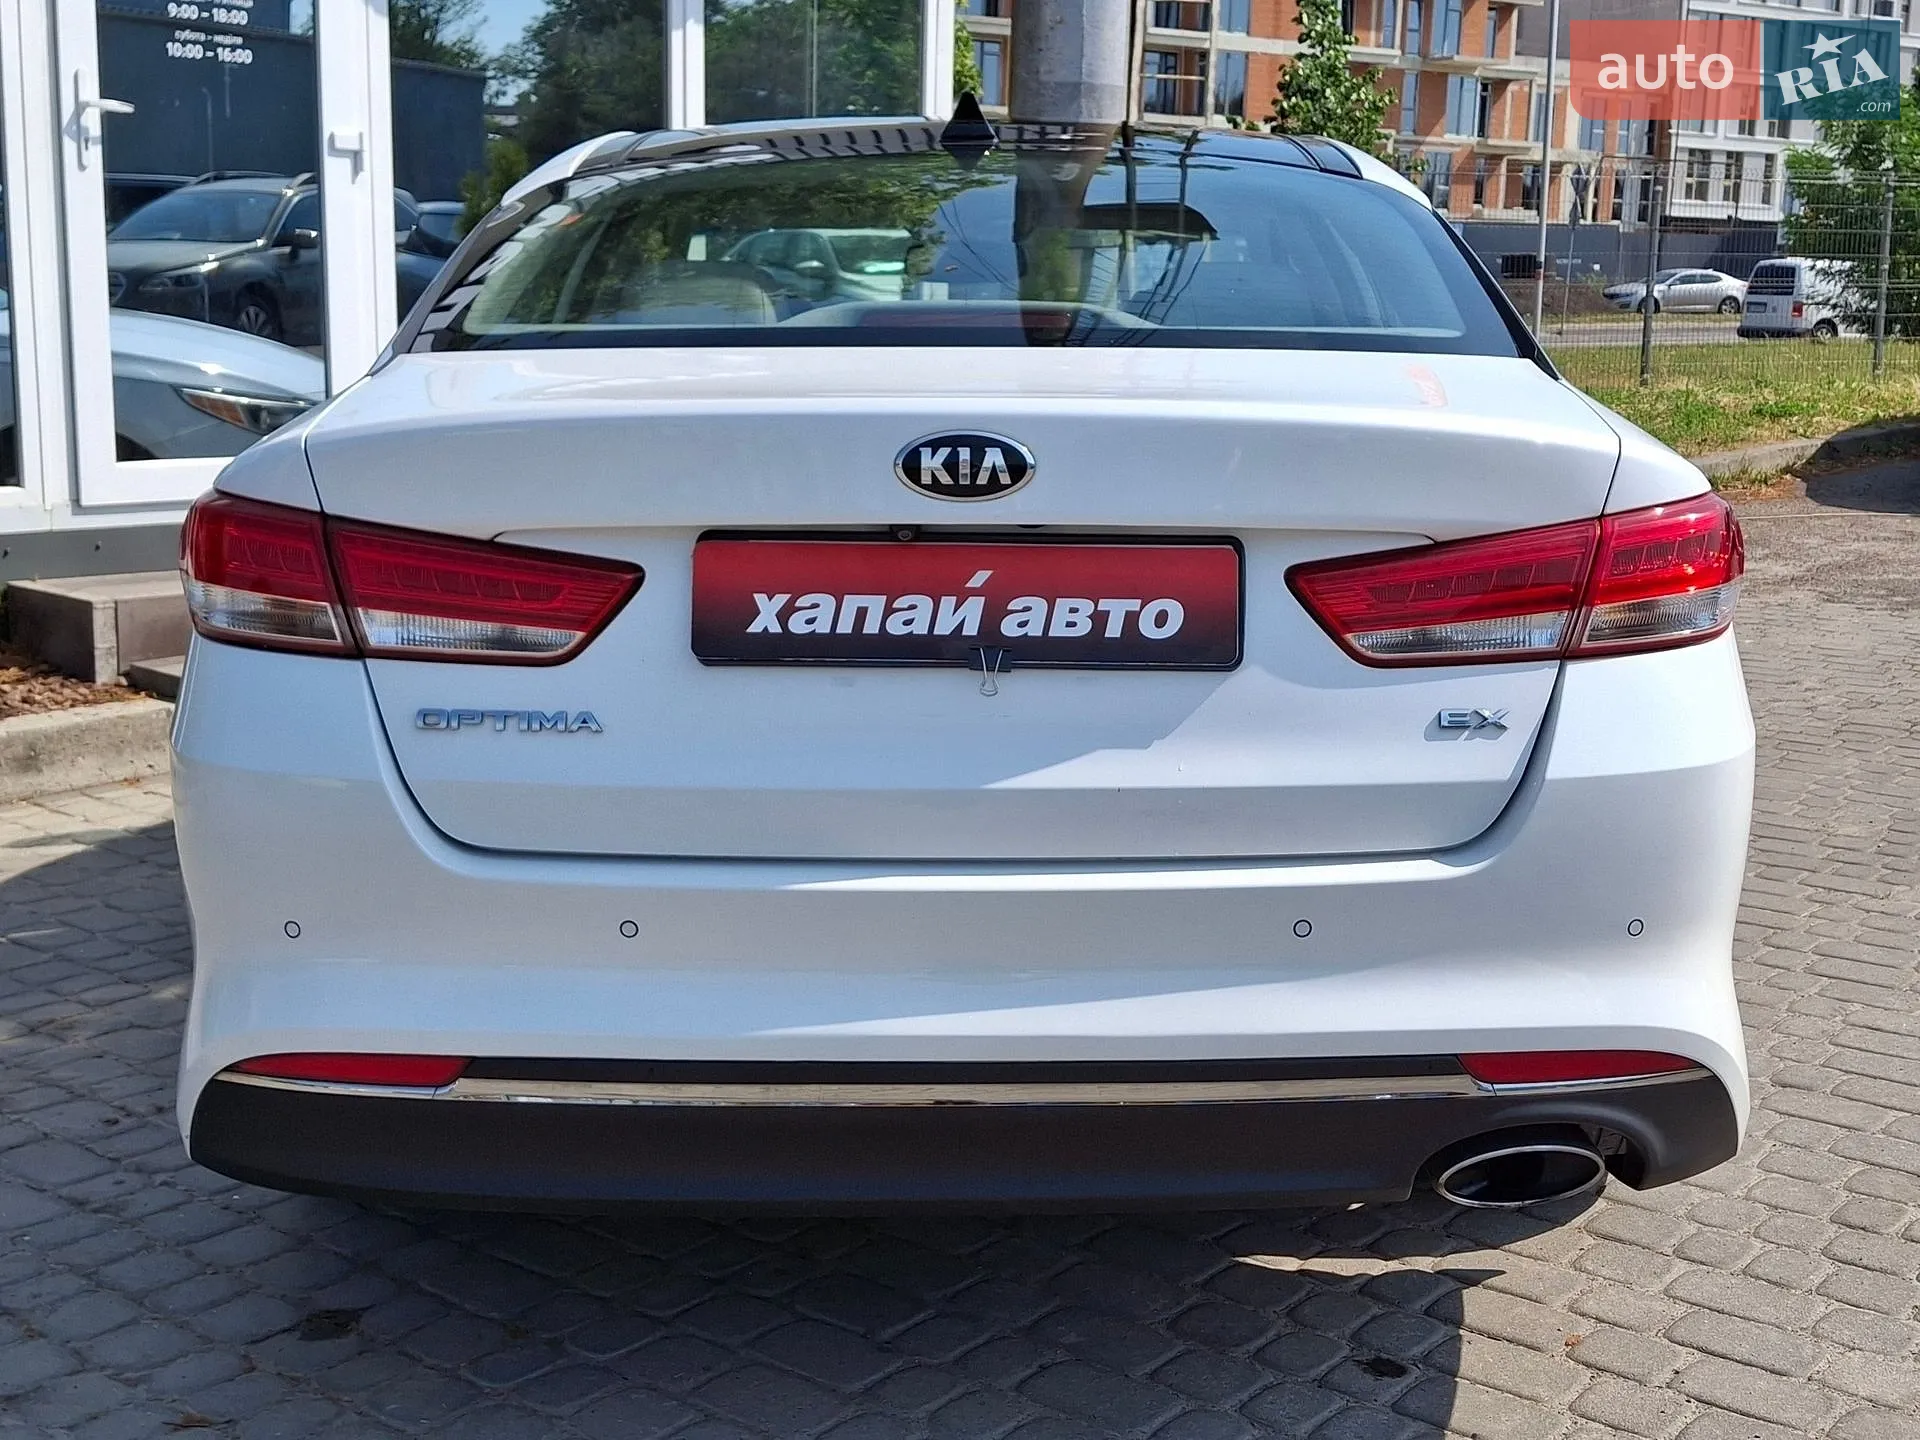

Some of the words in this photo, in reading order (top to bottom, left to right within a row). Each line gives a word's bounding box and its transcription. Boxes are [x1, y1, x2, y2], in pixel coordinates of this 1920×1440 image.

[167, 2, 199, 20] 9:00
[212, 7, 249, 26] 18:00
[166, 42, 204, 60] 10:00
[216, 46, 253, 65] 16:00
[918, 446, 1013, 485] KIA
[1000, 595, 1185, 640] авто
[415, 707, 603, 733] OPTIMA
[1438, 708, 1510, 730] EX
